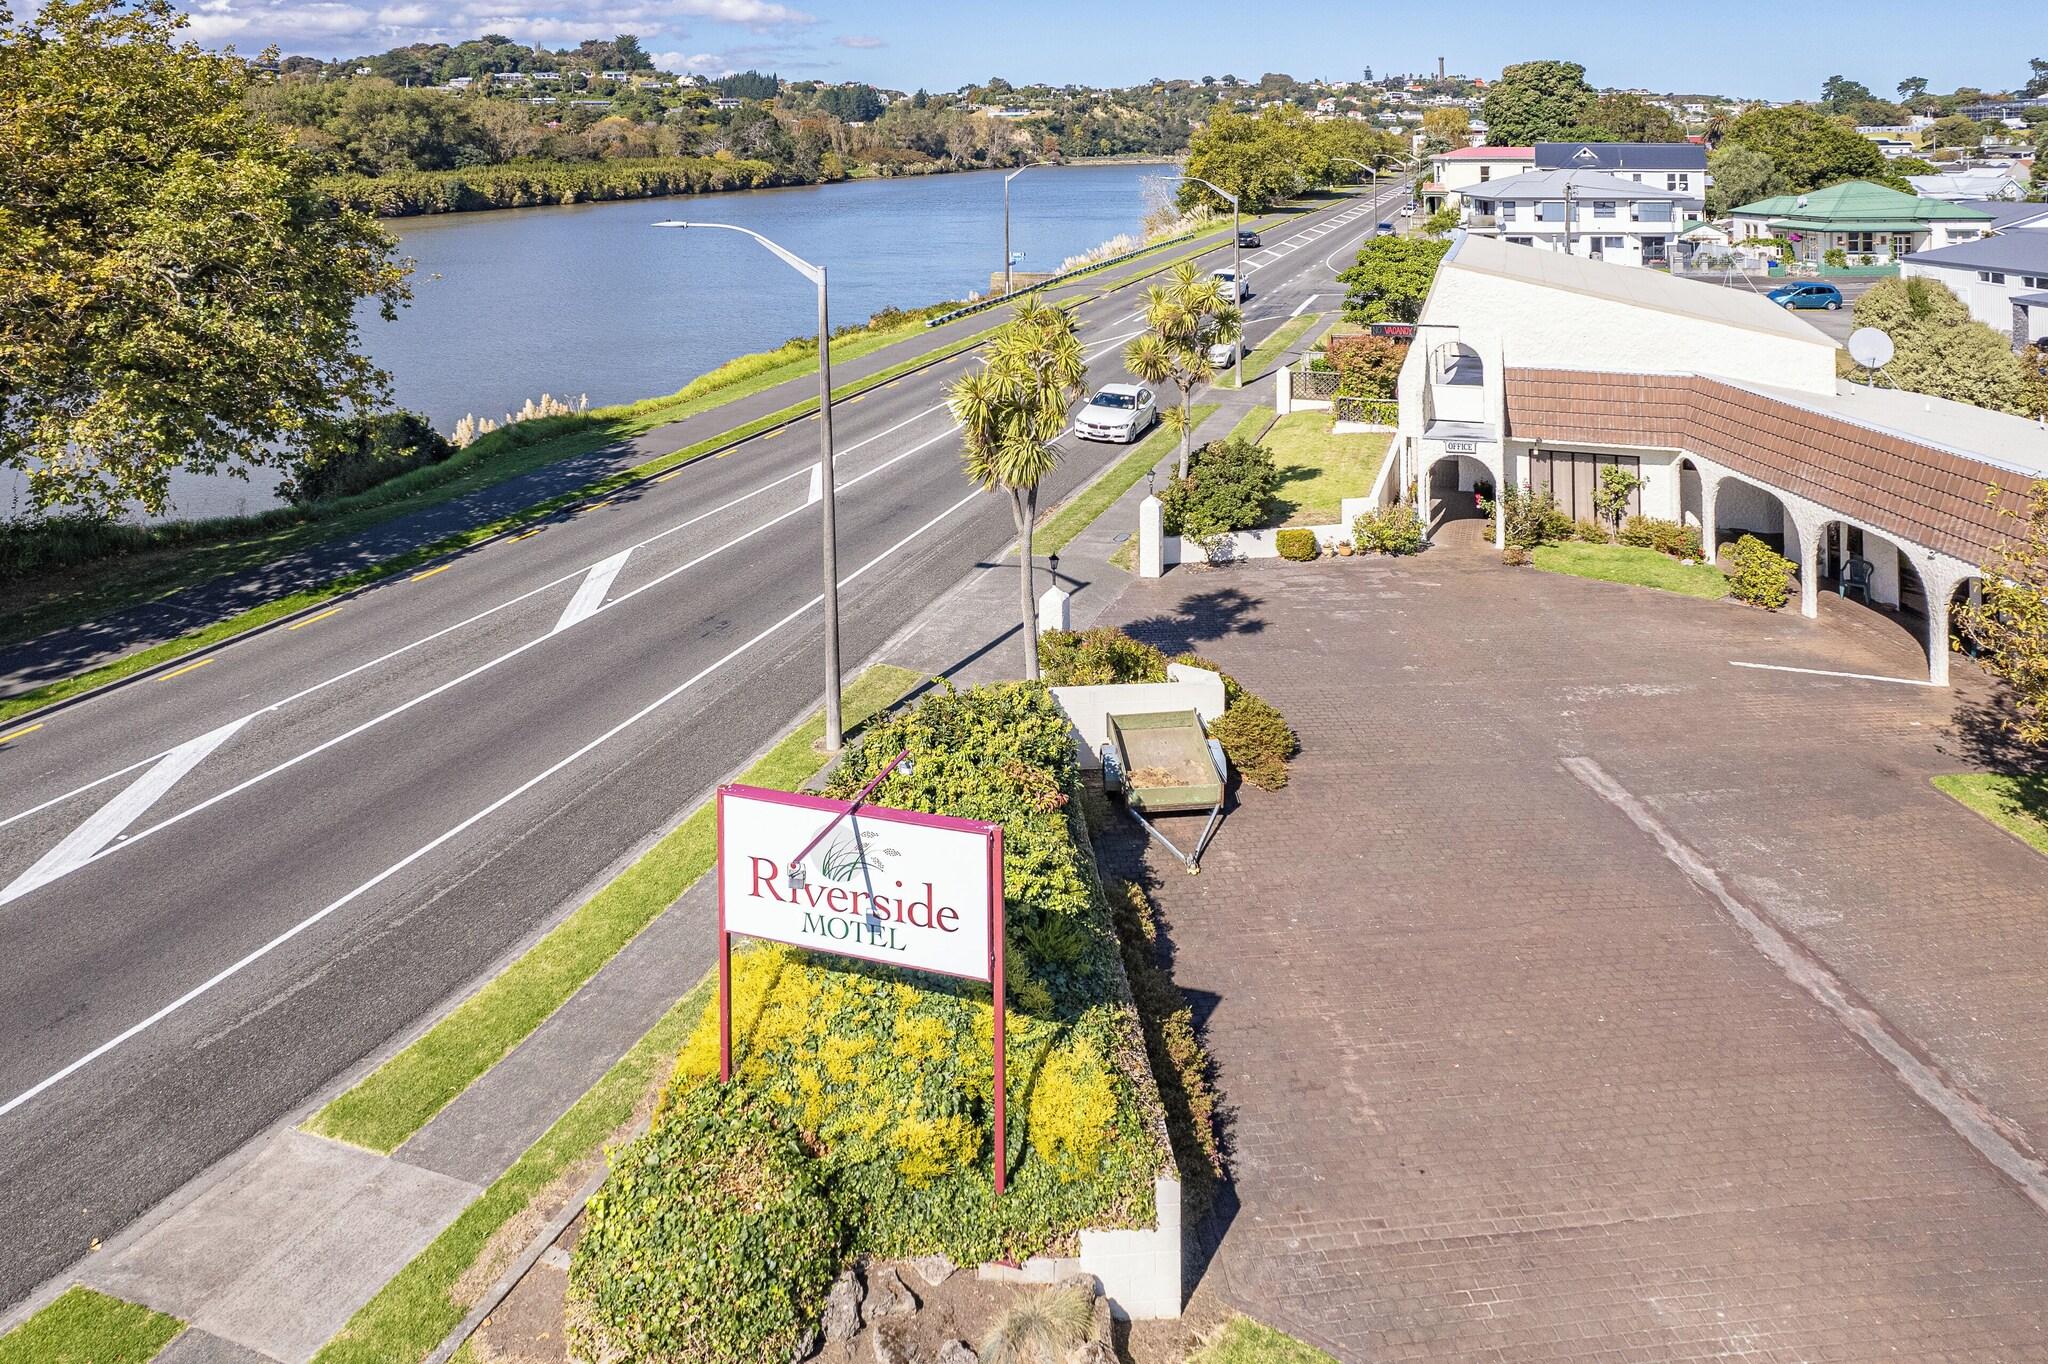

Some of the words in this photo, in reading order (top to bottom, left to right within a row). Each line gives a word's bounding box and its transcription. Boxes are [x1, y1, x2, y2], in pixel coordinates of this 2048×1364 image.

[1384, 326, 1412, 335] VACANCY
[1448, 442, 1472, 450] OFFICE
[747, 856, 960, 932] Riverside
[801, 912, 907, 951] MOTEL
